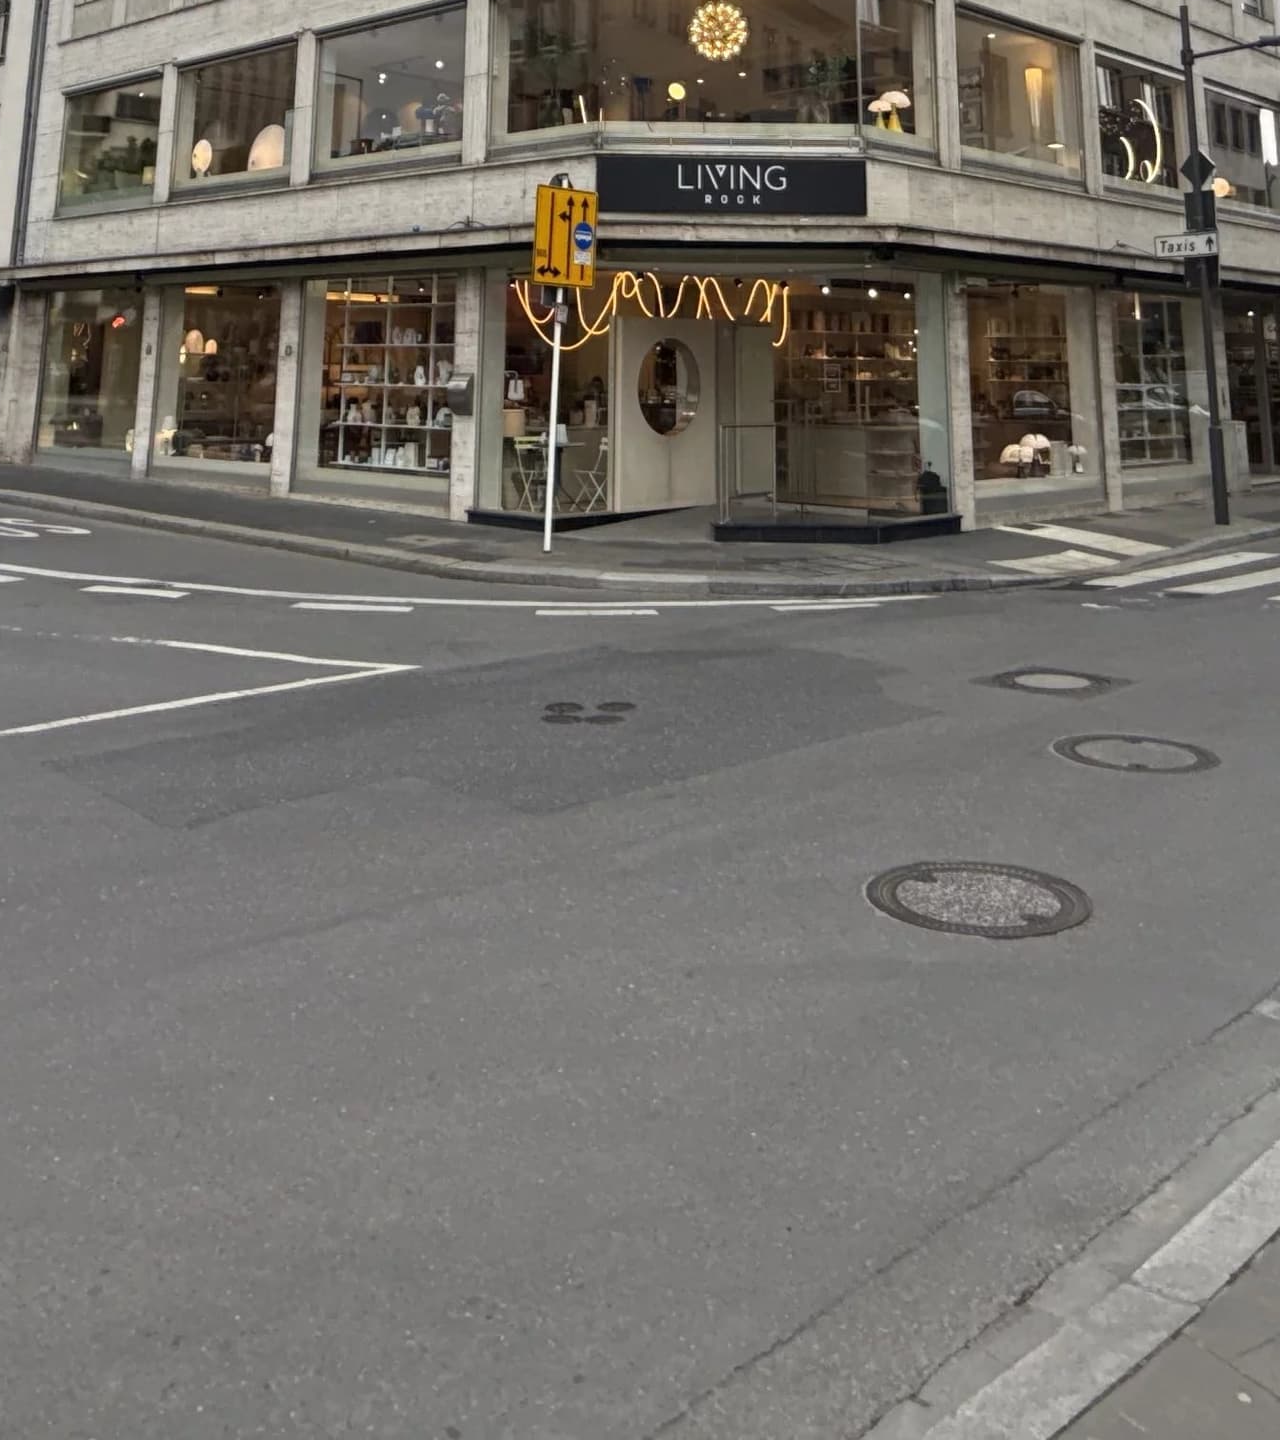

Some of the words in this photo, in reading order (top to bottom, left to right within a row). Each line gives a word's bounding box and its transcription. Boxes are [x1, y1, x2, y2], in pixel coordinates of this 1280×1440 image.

[678, 164, 787, 191] LIVING
[704, 194, 761, 204] ROCK
[1160, 239, 1196, 253] Taxis
